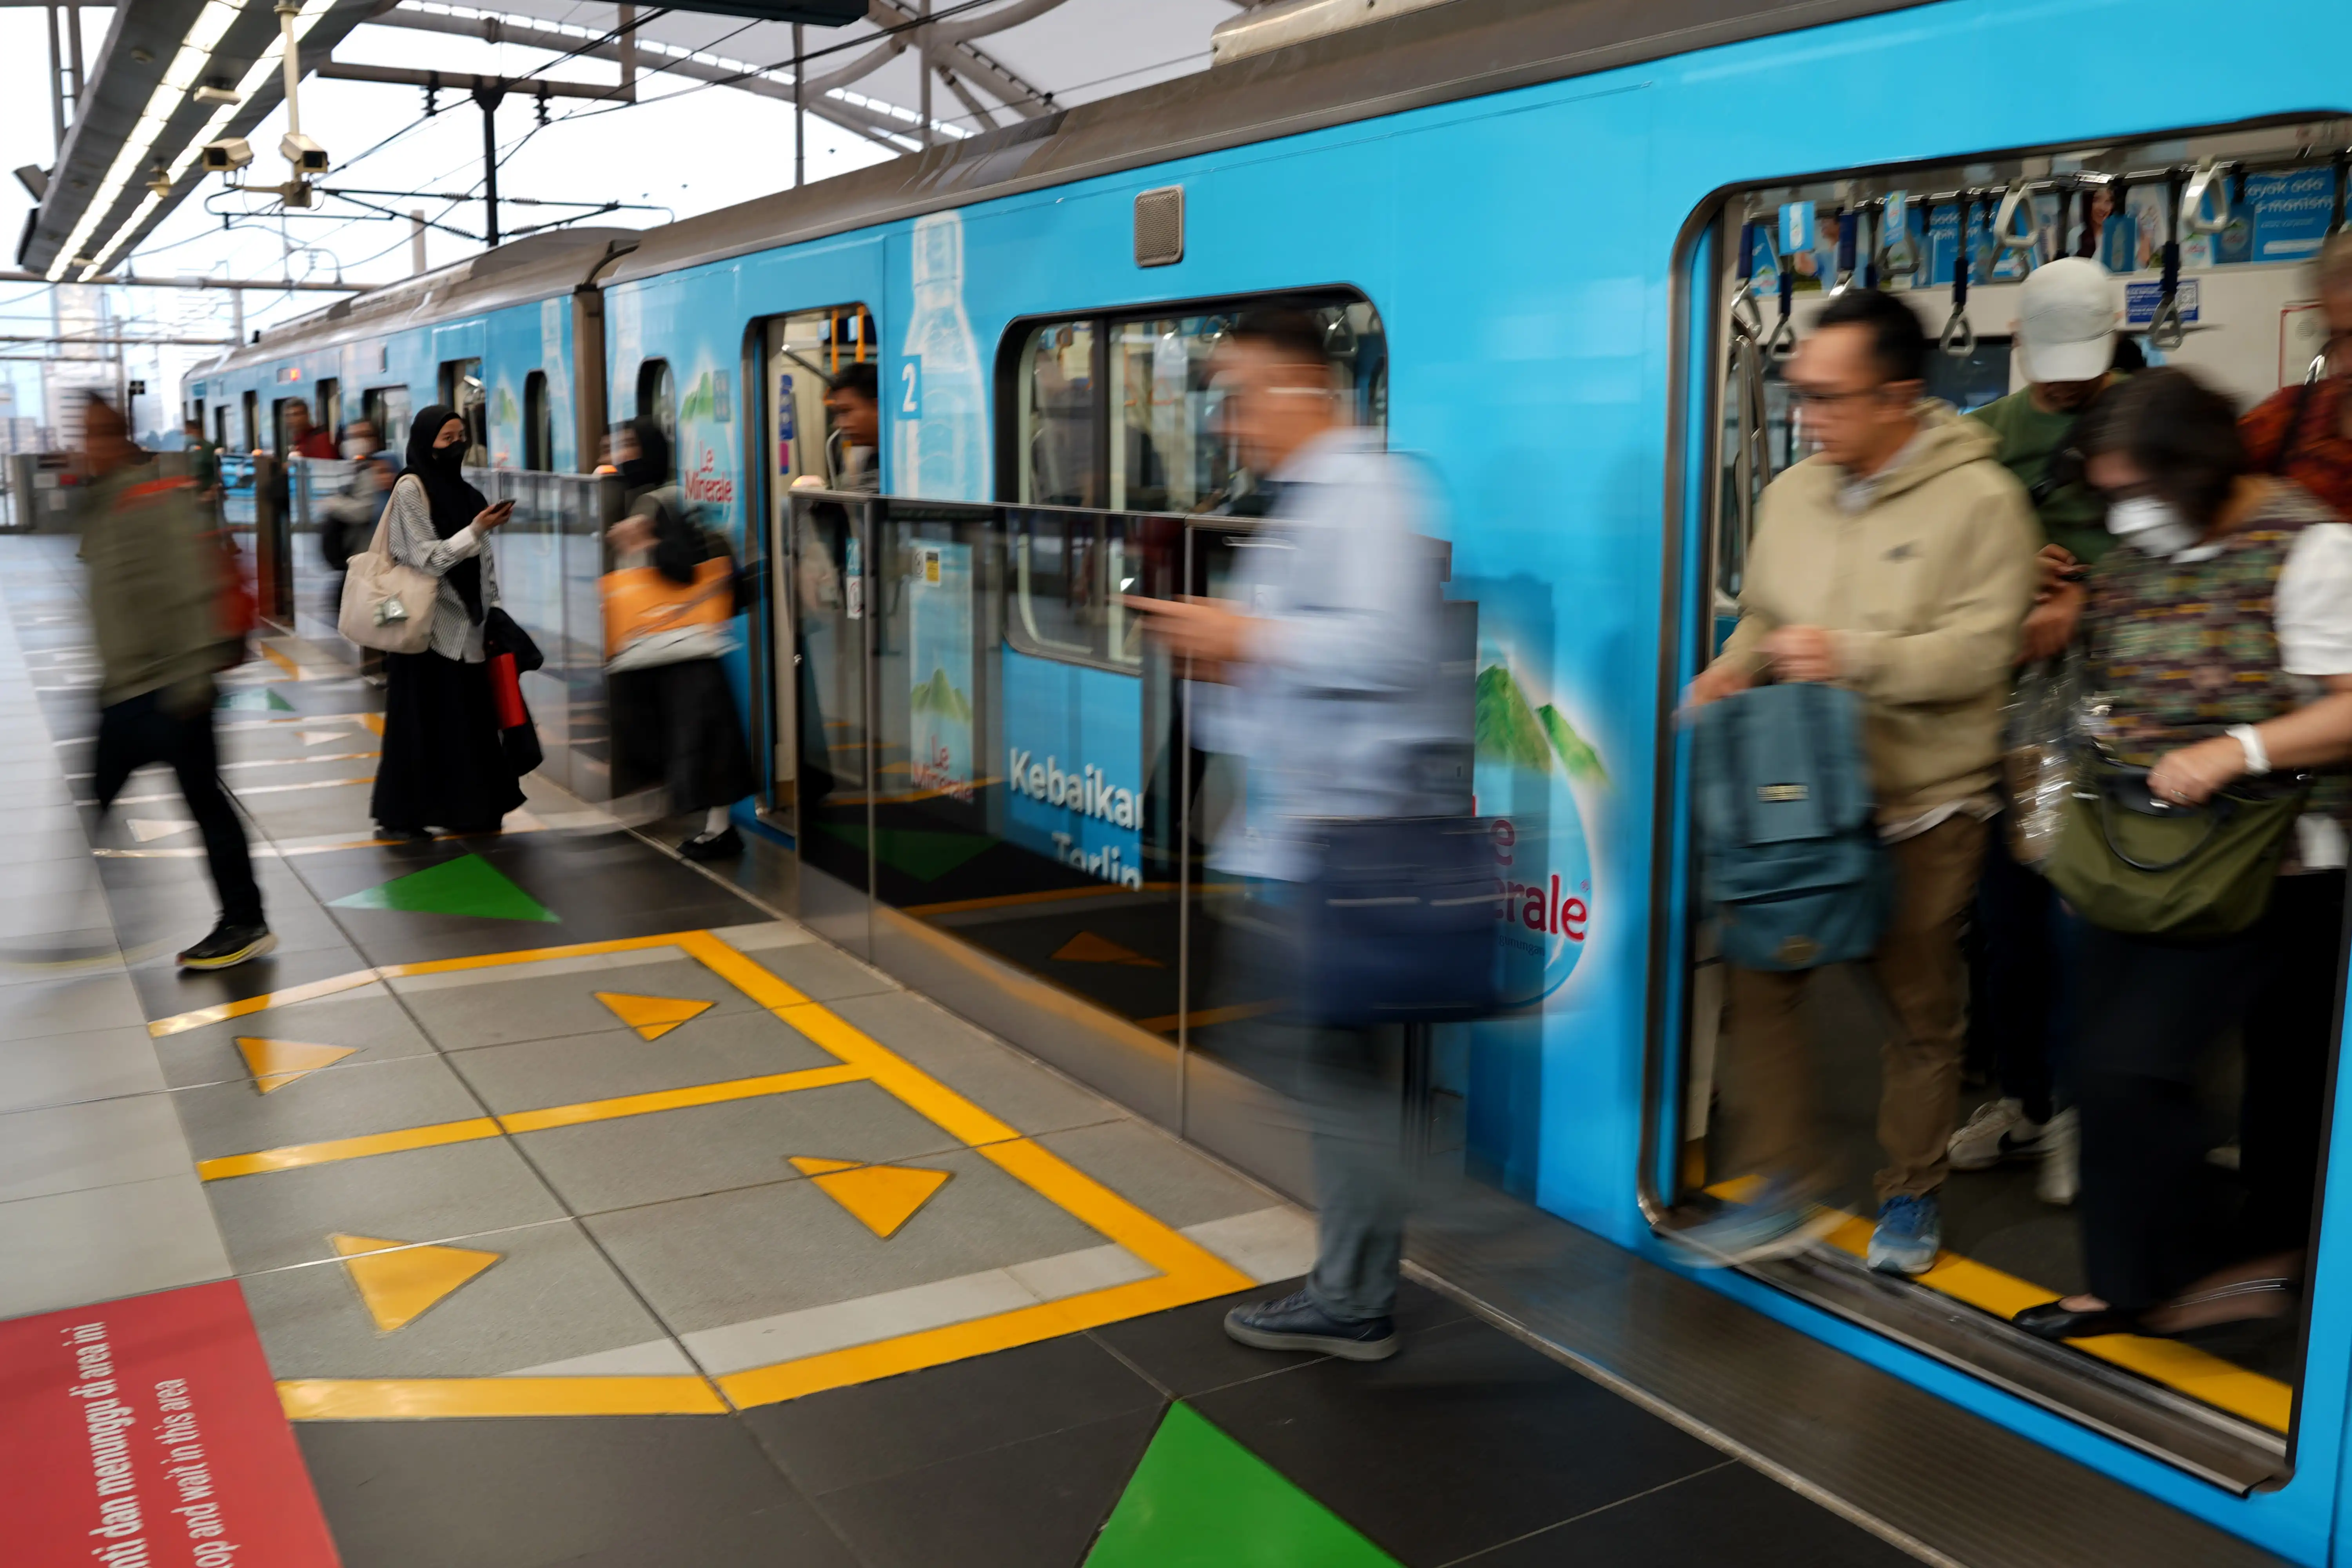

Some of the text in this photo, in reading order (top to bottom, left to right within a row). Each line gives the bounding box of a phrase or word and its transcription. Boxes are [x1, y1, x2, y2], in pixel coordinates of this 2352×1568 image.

[2244, 179, 2288, 198] ayak
[902, 363, 917, 412] 2
[700, 440, 714, 473] Le
[685, 469, 734, 503] Minerale
[1498, 935, 1545, 956] gunungan
[60, 1321, 108, 1347] ini
[75, 1342, 115, 1379] area
[68, 1378, 118, 1399] di
[83, 1397, 137, 1497] menunggu
[152, 1377, 242, 1568] op and wait in this area
[88, 1494, 144, 1538] dan
